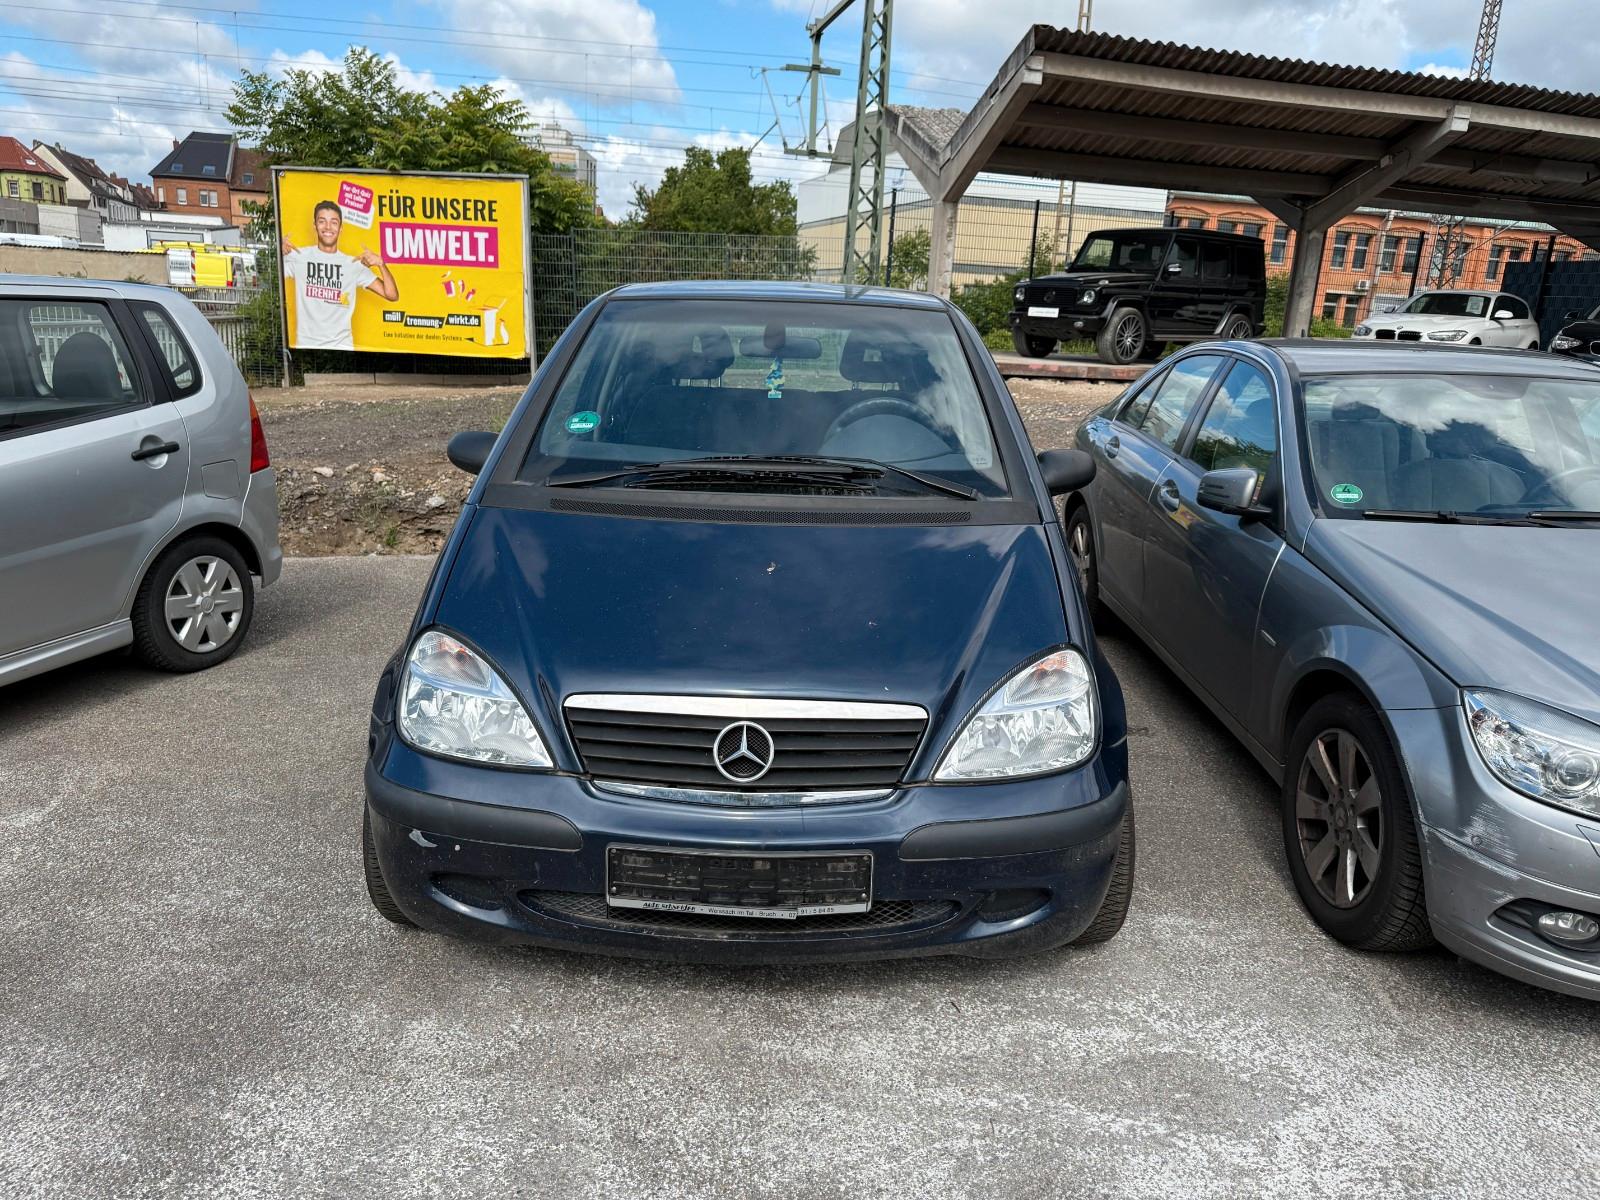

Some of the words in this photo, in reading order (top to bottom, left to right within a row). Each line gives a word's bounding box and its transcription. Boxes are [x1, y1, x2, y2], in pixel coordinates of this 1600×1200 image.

[378, 189, 416, 218] FÜR
[421, 197, 498, 222] UNSERE
[385, 227, 495, 263] UMWELT.
[307, 261, 344, 280] DEUT-
[306, 276, 342, 289] SCHLAND
[385, 312, 401, 321] müll
[448, 315, 479, 326] wirkt.de
